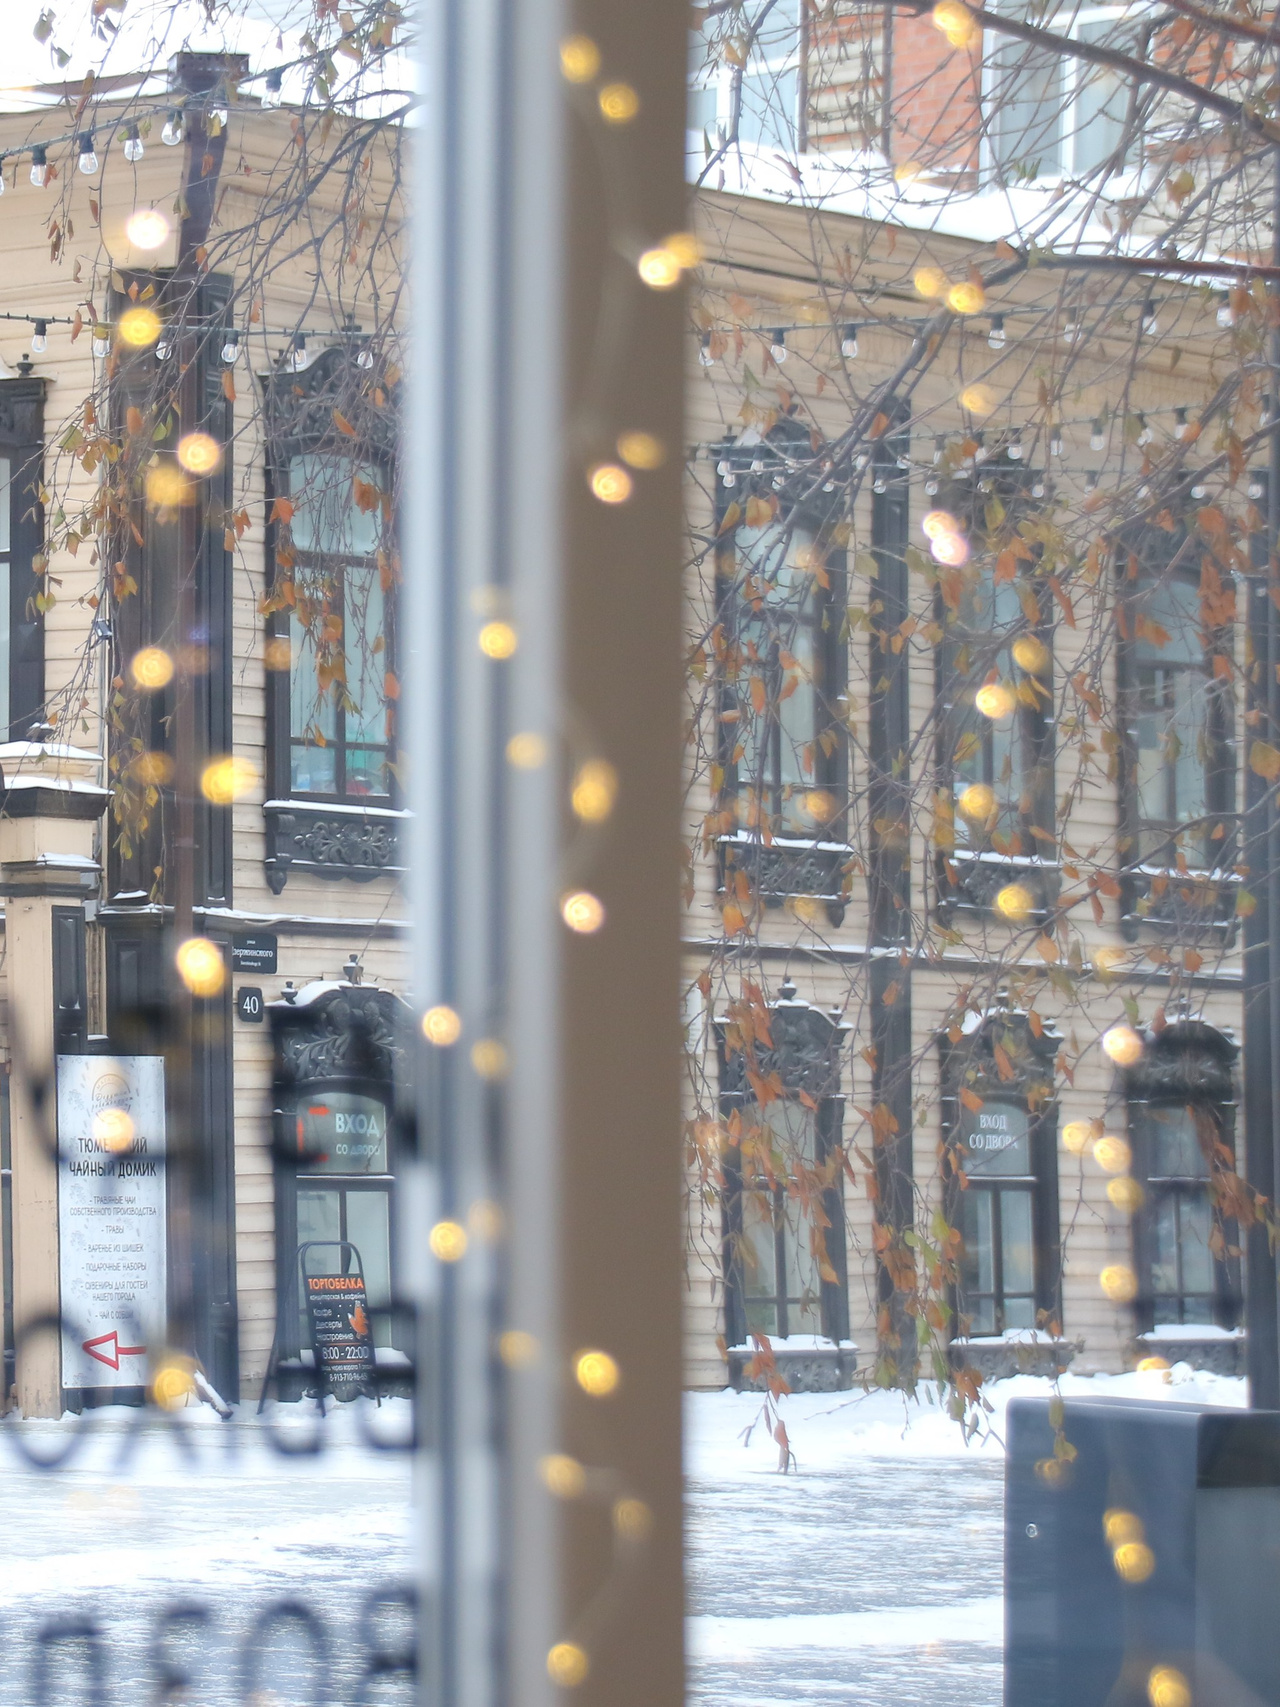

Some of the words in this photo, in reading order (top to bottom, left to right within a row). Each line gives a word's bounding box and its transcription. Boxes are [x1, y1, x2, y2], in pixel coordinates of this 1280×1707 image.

[243, 996, 259, 1014] 40
[335, 1113, 380, 1137] ВХОД
[980, 1114, 1007, 1132] ВХОД
[69, 1160, 115, 1176] ЧАЙНЫЙ
[118, 1161, 157, 1178] ДОМИК
[93, 1195, 124, 1205] ТРАВЯНЫЕ
[69, 1207, 111, 1216] СОБСТВЕННОГО
[112, 1207, 157, 1216] ПРОИЗВОДСТВА
[105, 1225, 125, 1234] ТРАВЫ
[87, 1244, 112, 1253] ВАРЕНЬЕ
[122, 1244, 144, 1253] ШИШЕК
[86, 1262, 121, 1271] ПОДАРОЧНЫЕ
[122, 1262, 147, 1271] НАБОРЫ
[308, 1278, 364, 1290] ТОРТОБЕЛКА
[345, 1346, 369, 1359] 22:00
